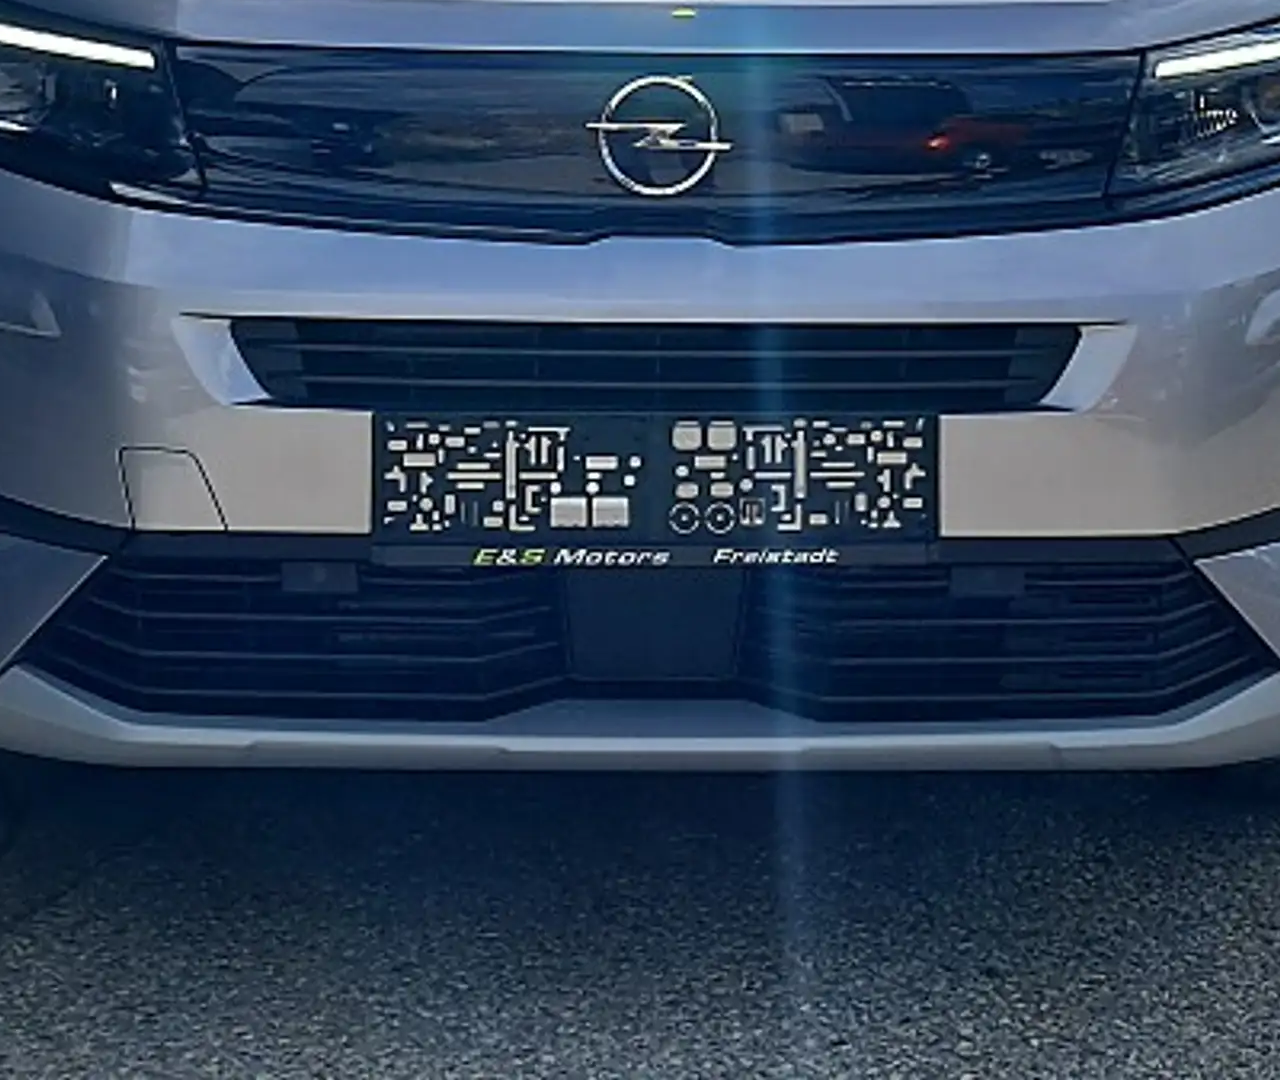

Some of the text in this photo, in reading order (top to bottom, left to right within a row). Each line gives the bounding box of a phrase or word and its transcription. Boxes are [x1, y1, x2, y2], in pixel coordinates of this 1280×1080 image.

[473, 548, 841, 566] E&S Motors Freistadt
